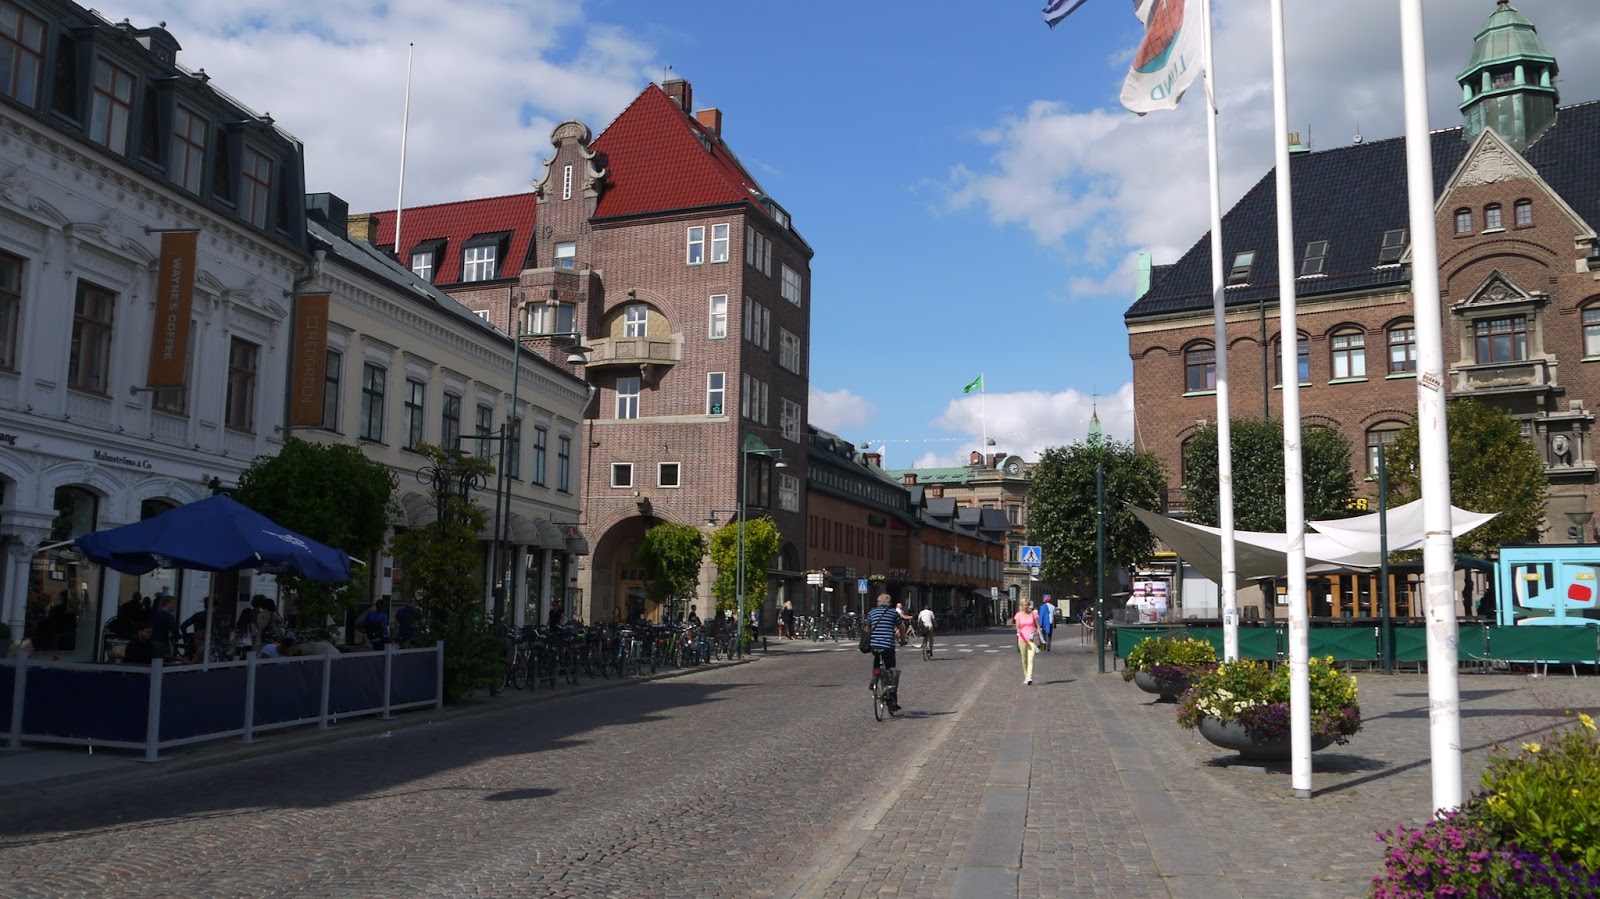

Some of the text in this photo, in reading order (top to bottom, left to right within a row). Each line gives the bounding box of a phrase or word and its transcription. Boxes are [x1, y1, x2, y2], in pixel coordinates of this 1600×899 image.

[163, 257, 182, 361] WAYNE'S COFFEE
[301, 331, 318, 404] REDGREEN
[93, 449, 136, 467] Malmströms
[142, 459, 153, 469] Co
